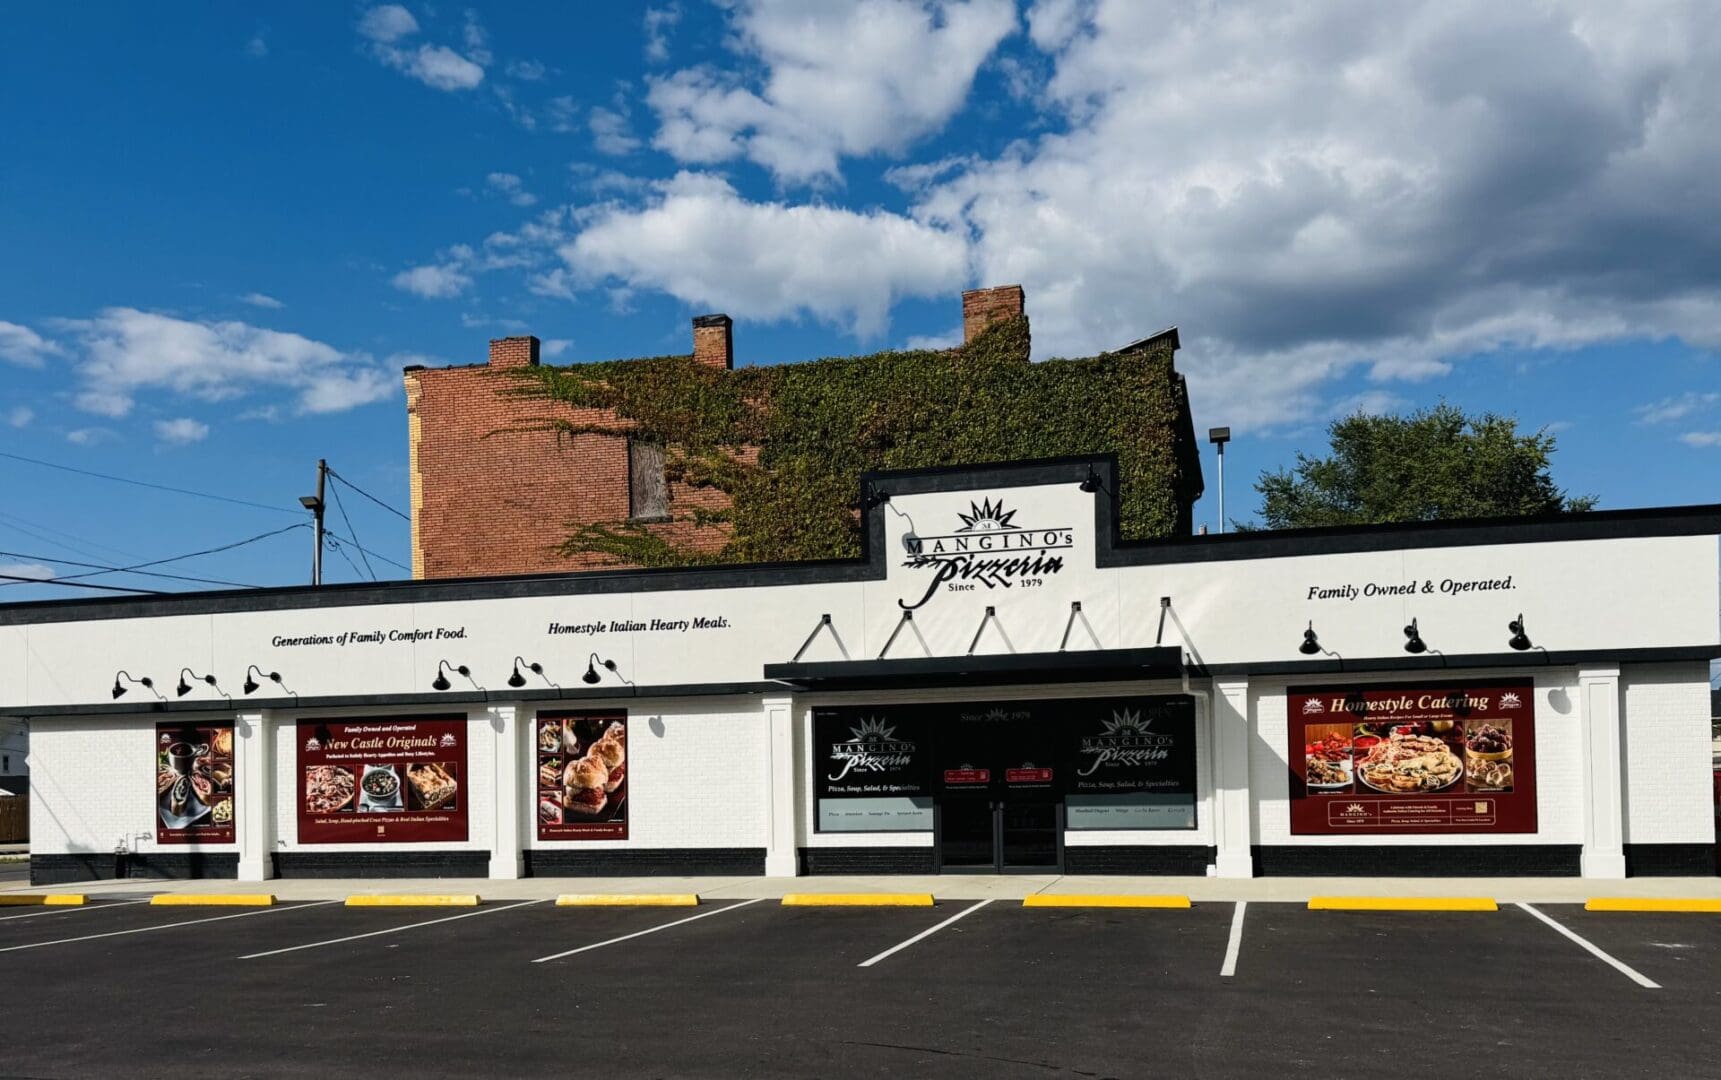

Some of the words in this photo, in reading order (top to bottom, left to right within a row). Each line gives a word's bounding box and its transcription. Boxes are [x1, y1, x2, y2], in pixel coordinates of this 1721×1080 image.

[907, 532, 1073, 554] MANGINO's
[948, 583, 975, 592] Since
[1020, 579, 1043, 588] 1979
[1307, 584, 1359, 601] Family
[1363, 581, 1416, 597] Owned
[1421, 580, 1435, 594] &
[1440, 576, 1516, 595] Operated.
[548, 621, 606, 636] Homestyle
[609, 619, 647, 633] Italian
[649, 618, 689, 632] Hearty
[692, 616, 731, 629] Meals.
[272, 634, 334, 647] Generations
[336, 632, 349, 646] of
[349, 631, 386, 645] Family
[388, 629, 433, 643] Comfort
[435, 627, 468, 640] Food.
[1330, 696, 1414, 714] Homestyle
[1418, 694, 1489, 711] Catering
[393, 724, 416, 732] Operated
[324, 737, 349, 750] New
[350, 736, 384, 749] Castle
[386, 735, 437, 750] Originals
